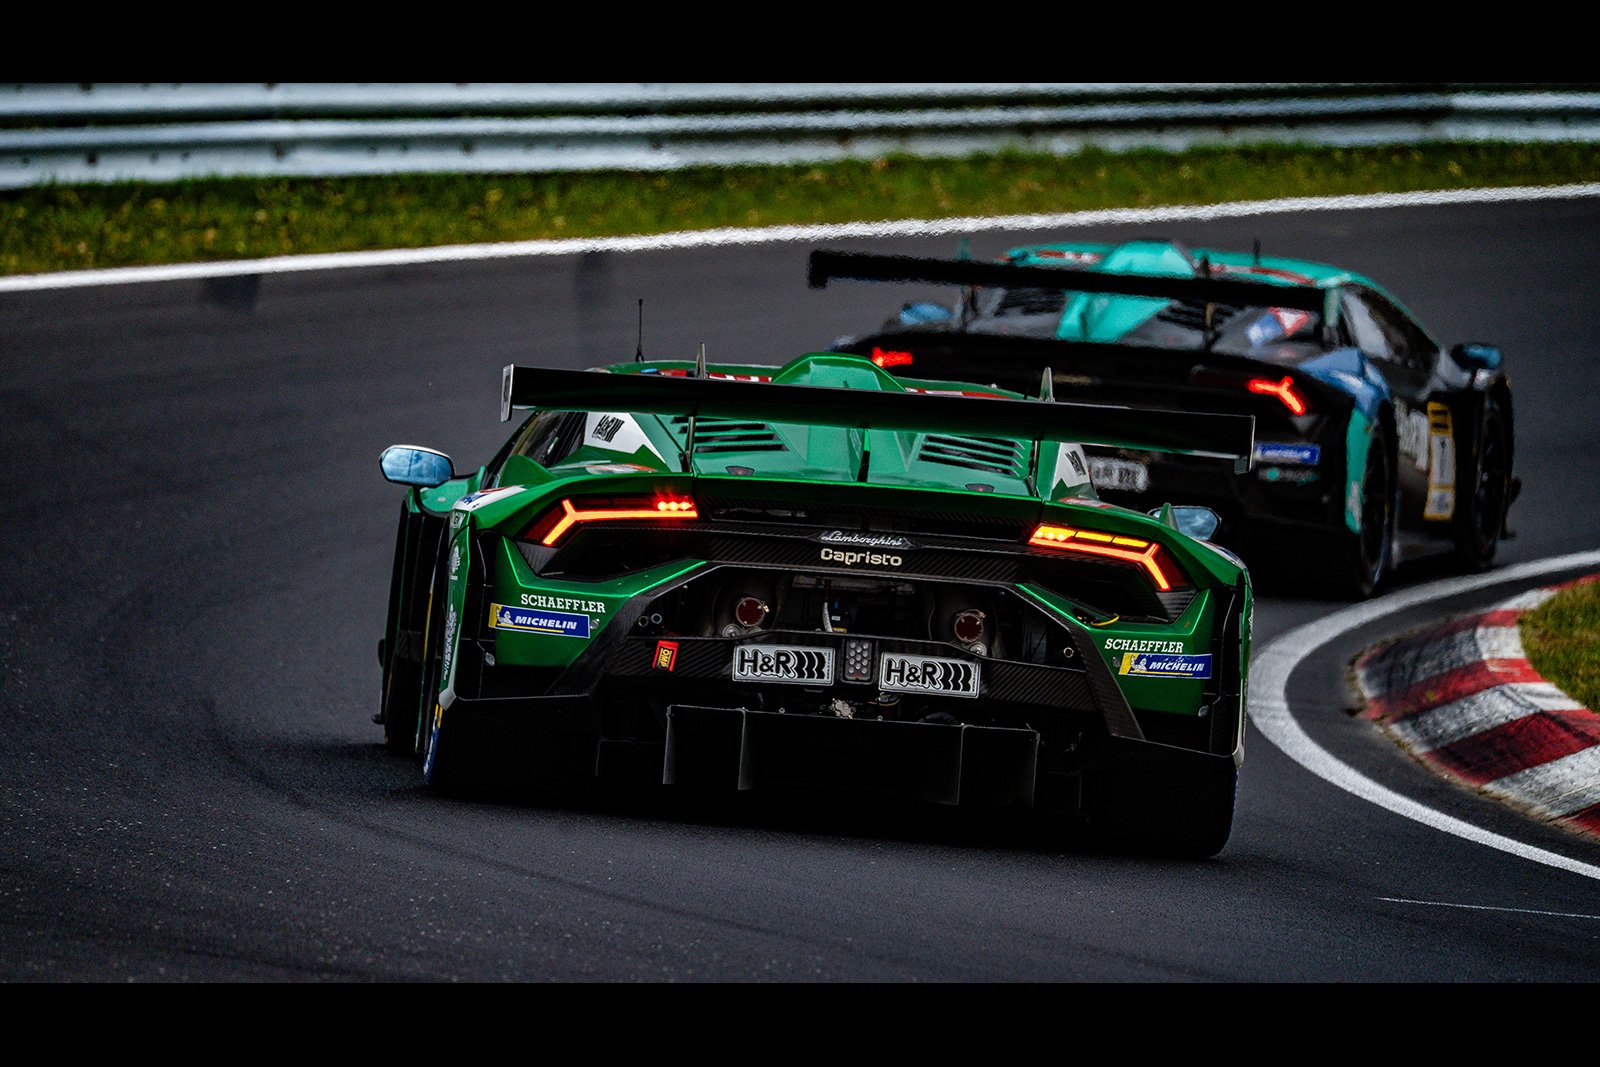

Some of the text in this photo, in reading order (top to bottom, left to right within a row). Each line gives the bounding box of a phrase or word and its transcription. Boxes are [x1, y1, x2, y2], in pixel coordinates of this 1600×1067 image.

[821, 530, 902, 546] Lamborghini
[820, 548, 902, 566] Capristo
[521, 593, 606, 613] SCHAEFFLER
[515, 615, 577, 629] MICHELIN
[1104, 638, 1184, 653] SCHAEFFLER
[660, 648, 670, 667] OMP
[738, 648, 795, 677] H&R
[1149, 661, 1205, 672] MICHELIN
[885, 658, 940, 689] H&R
